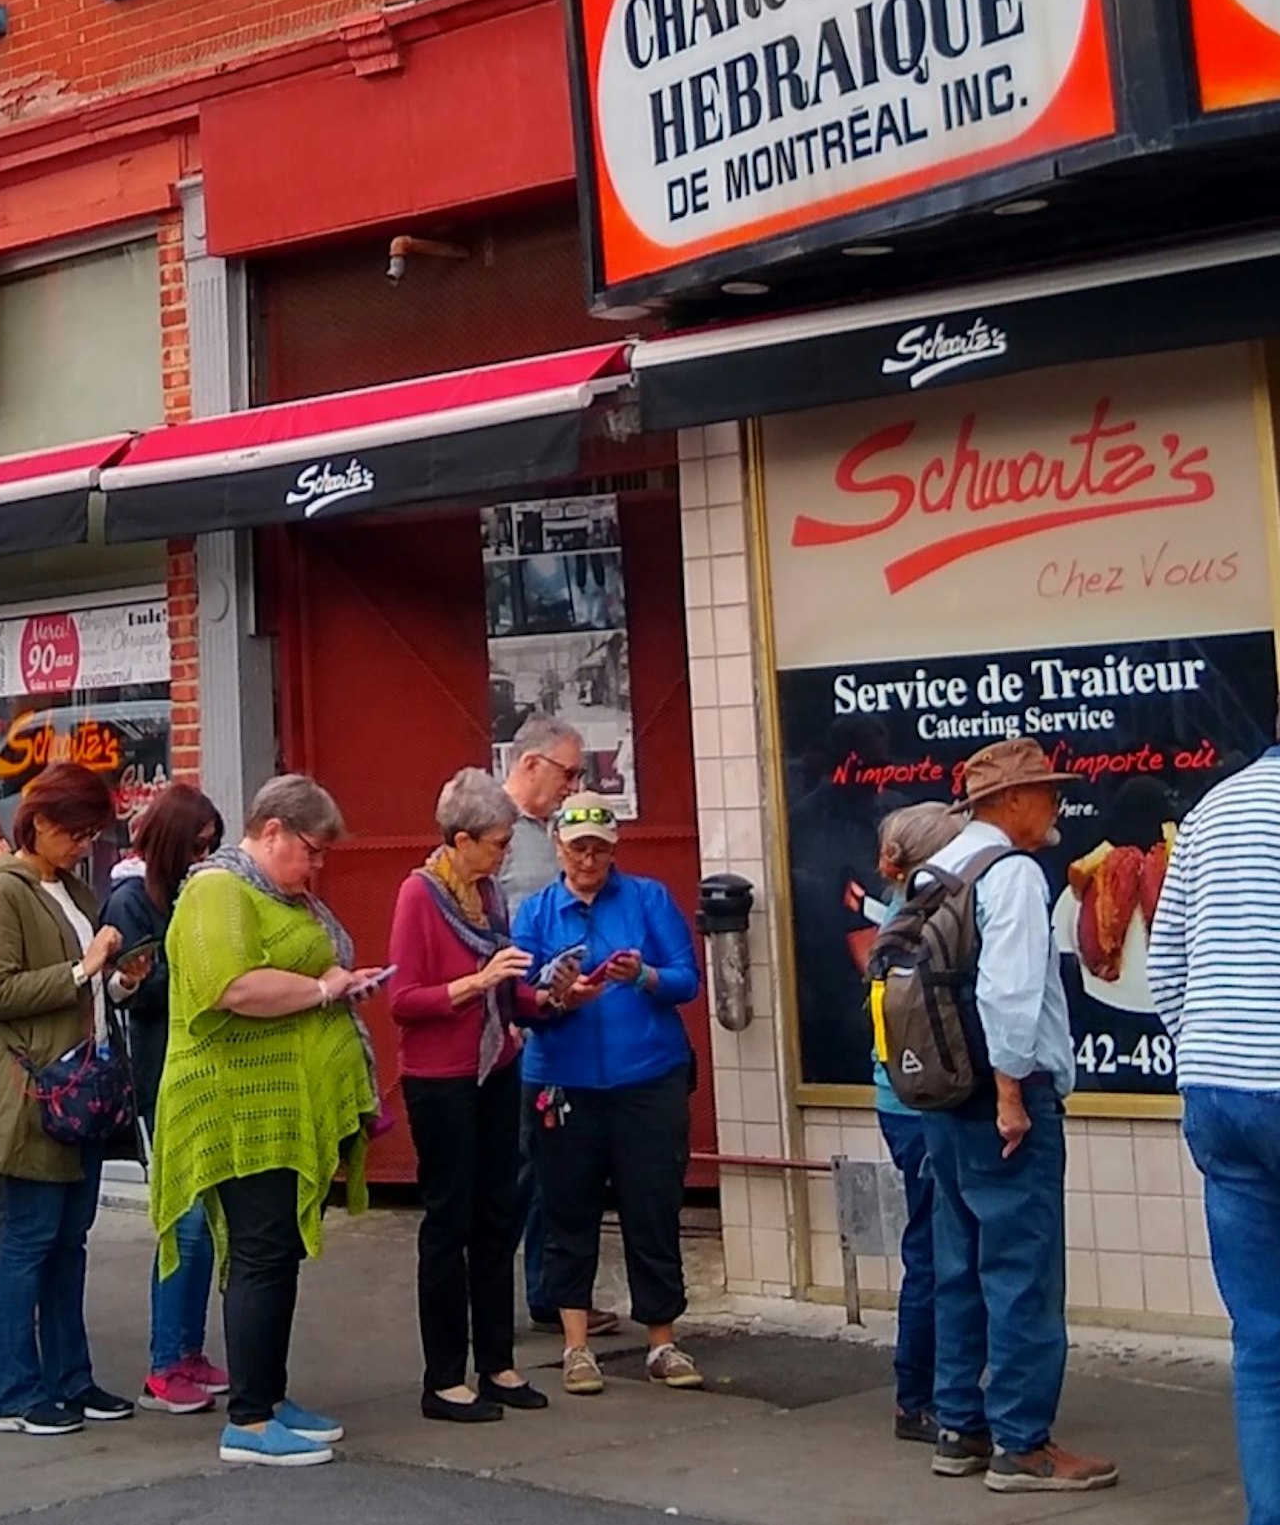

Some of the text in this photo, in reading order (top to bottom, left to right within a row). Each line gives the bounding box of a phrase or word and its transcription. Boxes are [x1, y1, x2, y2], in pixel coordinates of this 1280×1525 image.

[668, 65, 1028, 222] DE MONTRÉAL INC.
[883, 316, 1007, 388] Schwartz's
[791, 397, 1215, 595] Schwartz's
[1037, 541, 1238, 599] Chez Vous
[26, 643, 56, 678] 90
[834, 655, 1205, 714] Service de Traiteur
[918, 705, 1114, 740] Catering Service
[1070, 1034, 1176, 1074] 42-48
